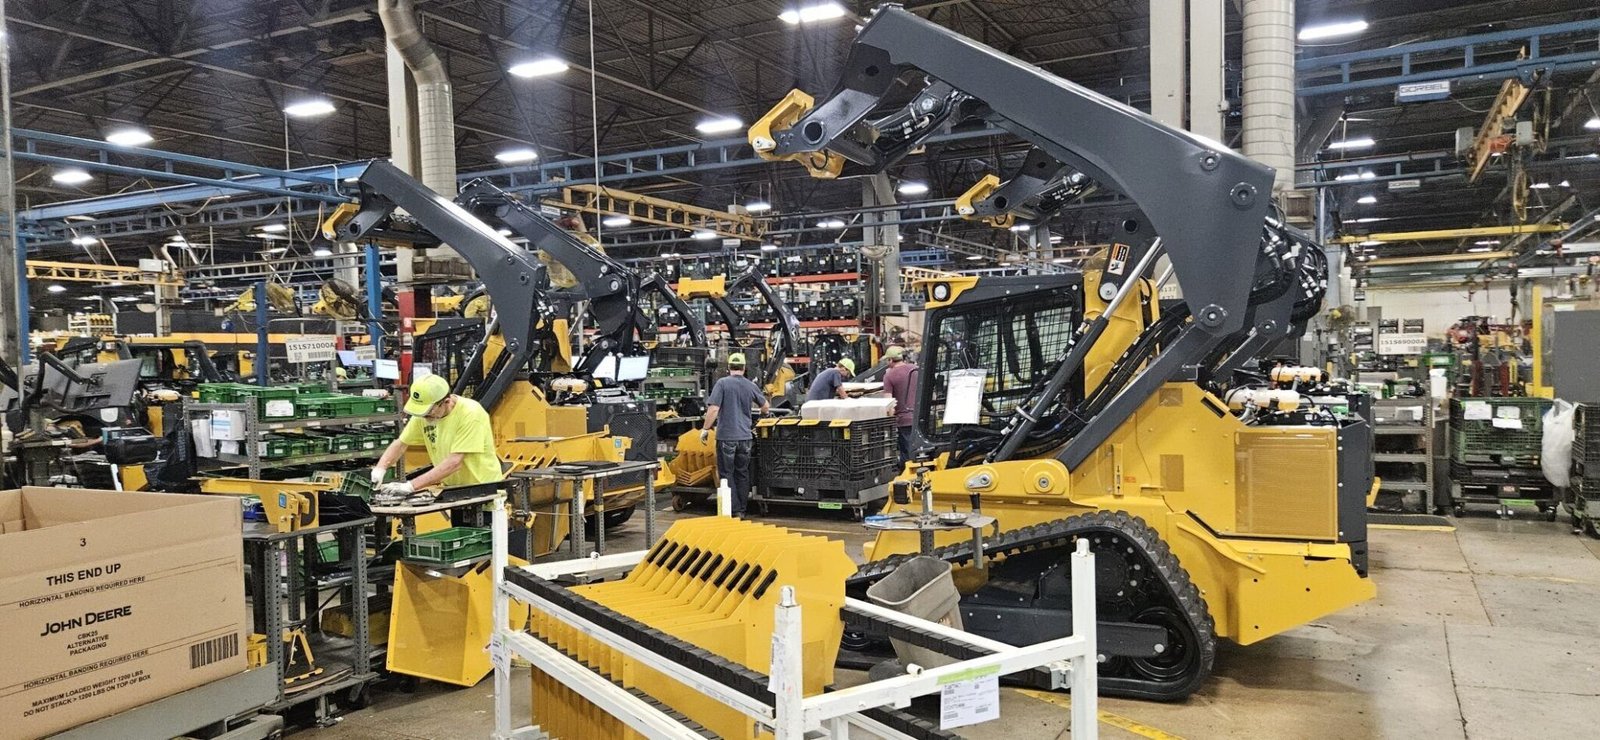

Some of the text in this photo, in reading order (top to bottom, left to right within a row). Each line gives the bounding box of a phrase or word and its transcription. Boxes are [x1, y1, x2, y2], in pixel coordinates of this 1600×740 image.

[1400, 82, 1449, 93] GORBEL
[80, 538, 86, 547] 3
[45, 563, 121, 586] THIS END UP
[19, 575, 146, 608] HORIZONTAL BANDING REQUIRED HERE
[40, 605, 132, 637] JOHN DEERE
[67, 634, 109, 650] ALTERNATIVE
[77, 630, 98, 640] CBK25
[69, 642, 107, 656] PACKAGING
[23, 649, 149, 690] HORIZONTAL BANDING REQUIRED HERE
[23, 708, 34, 717] DO
[35, 704, 49, 714] NOT
[50, 698, 72, 709] STACK
[78, 692, 92, 701] 1200
[92, 688, 106, 696] LBS
[106, 684, 116, 692] ON
[116, 682, 129, 690] TOP
[129, 679, 137, 687] OF
[138, 674, 151, 683] BOX
[32, 670, 144, 707] MAXIMUM LOADED WEIGHT 1200 LBS
